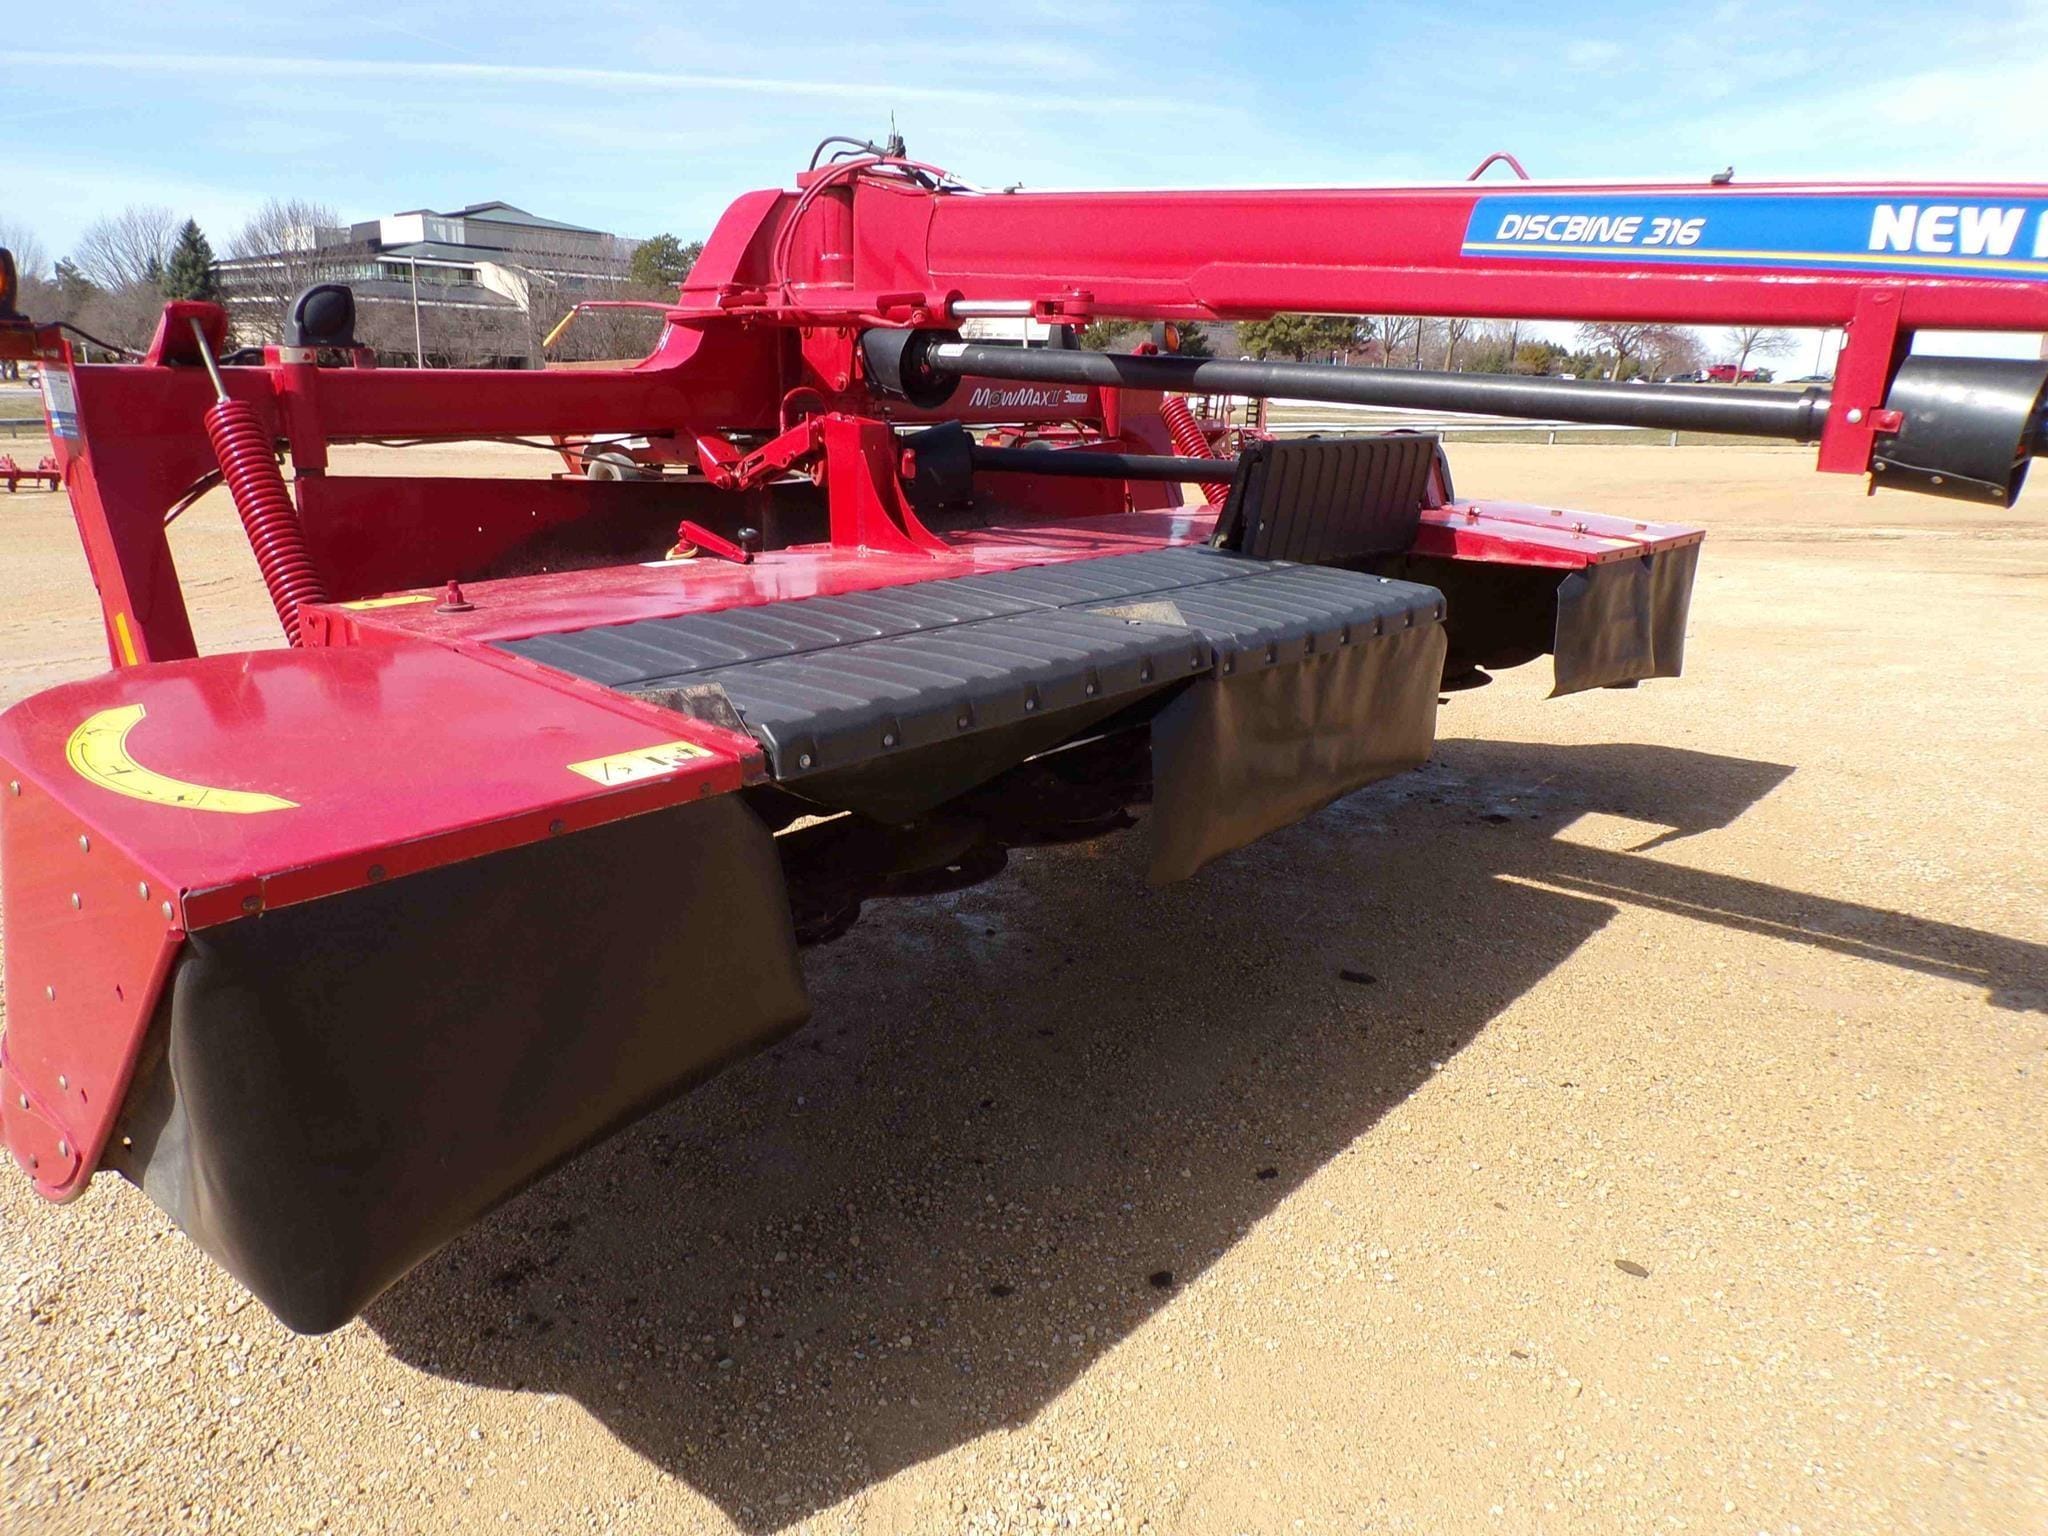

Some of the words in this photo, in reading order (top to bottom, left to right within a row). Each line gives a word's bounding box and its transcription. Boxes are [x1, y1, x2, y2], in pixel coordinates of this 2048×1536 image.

[1496, 214, 1643, 243] DISCBINE
[1641, 217, 1706, 246] 316
[1868, 204, 2026, 256] NEW
